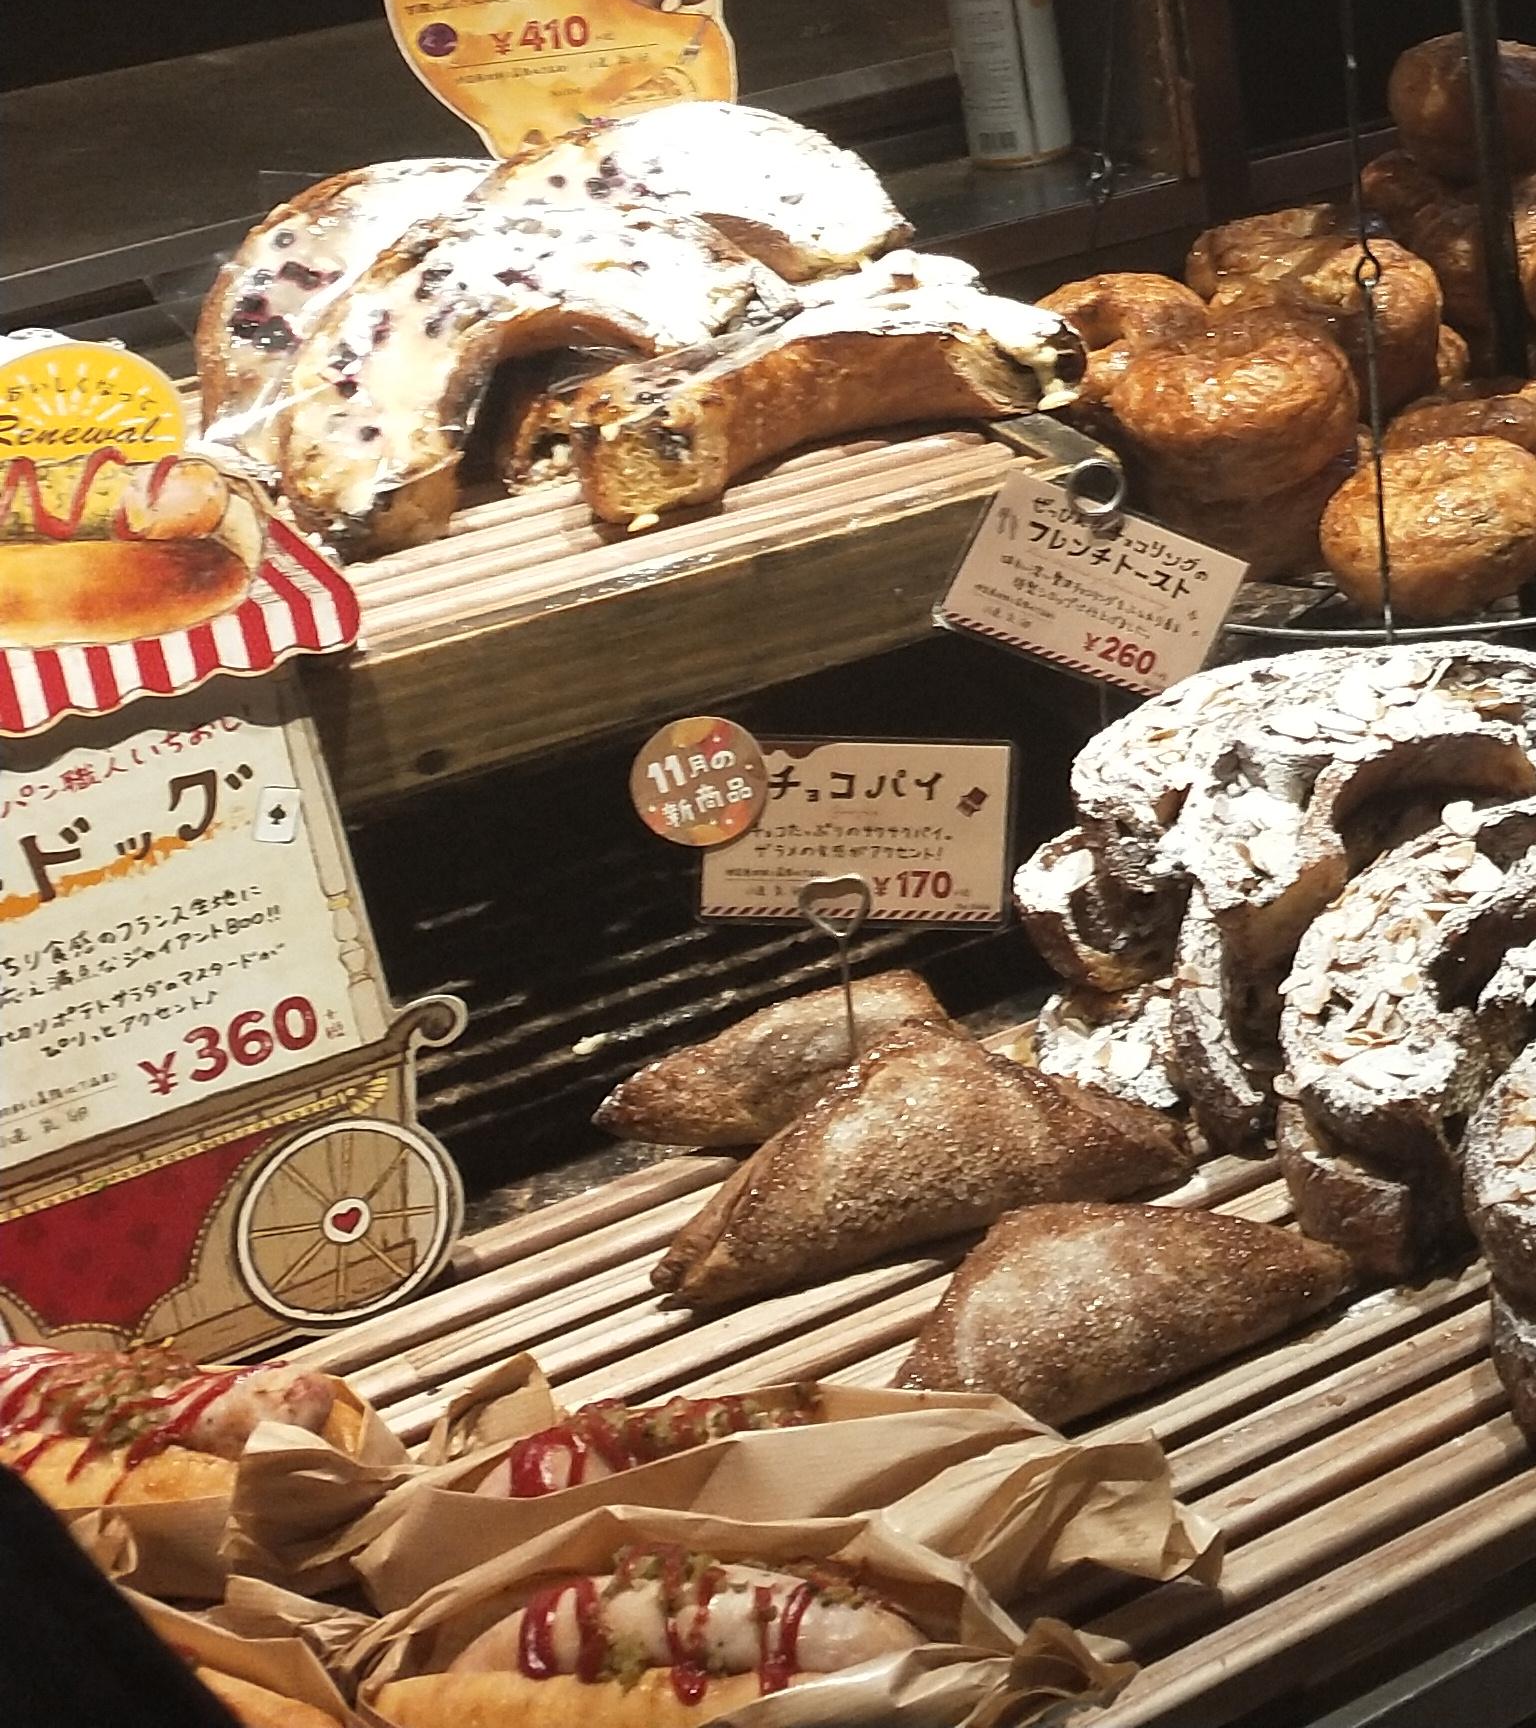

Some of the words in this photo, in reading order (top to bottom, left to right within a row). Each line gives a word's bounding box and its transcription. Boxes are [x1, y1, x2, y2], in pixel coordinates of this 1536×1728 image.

[489, 15, 590, 55] ¥410
[1028, 520, 1191, 599] フレンチトースト
[1083, 631, 1157, 676] ¥260
[647, 749, 737, 796] 11月の
[766, 764, 945, 803] チョコパイ
[661, 775, 755, 829] 新商品
[0, 763, 254, 903] ドッグ
[873, 869, 953, 900] ¥170
[137, 996, 318, 1096] ¥360
